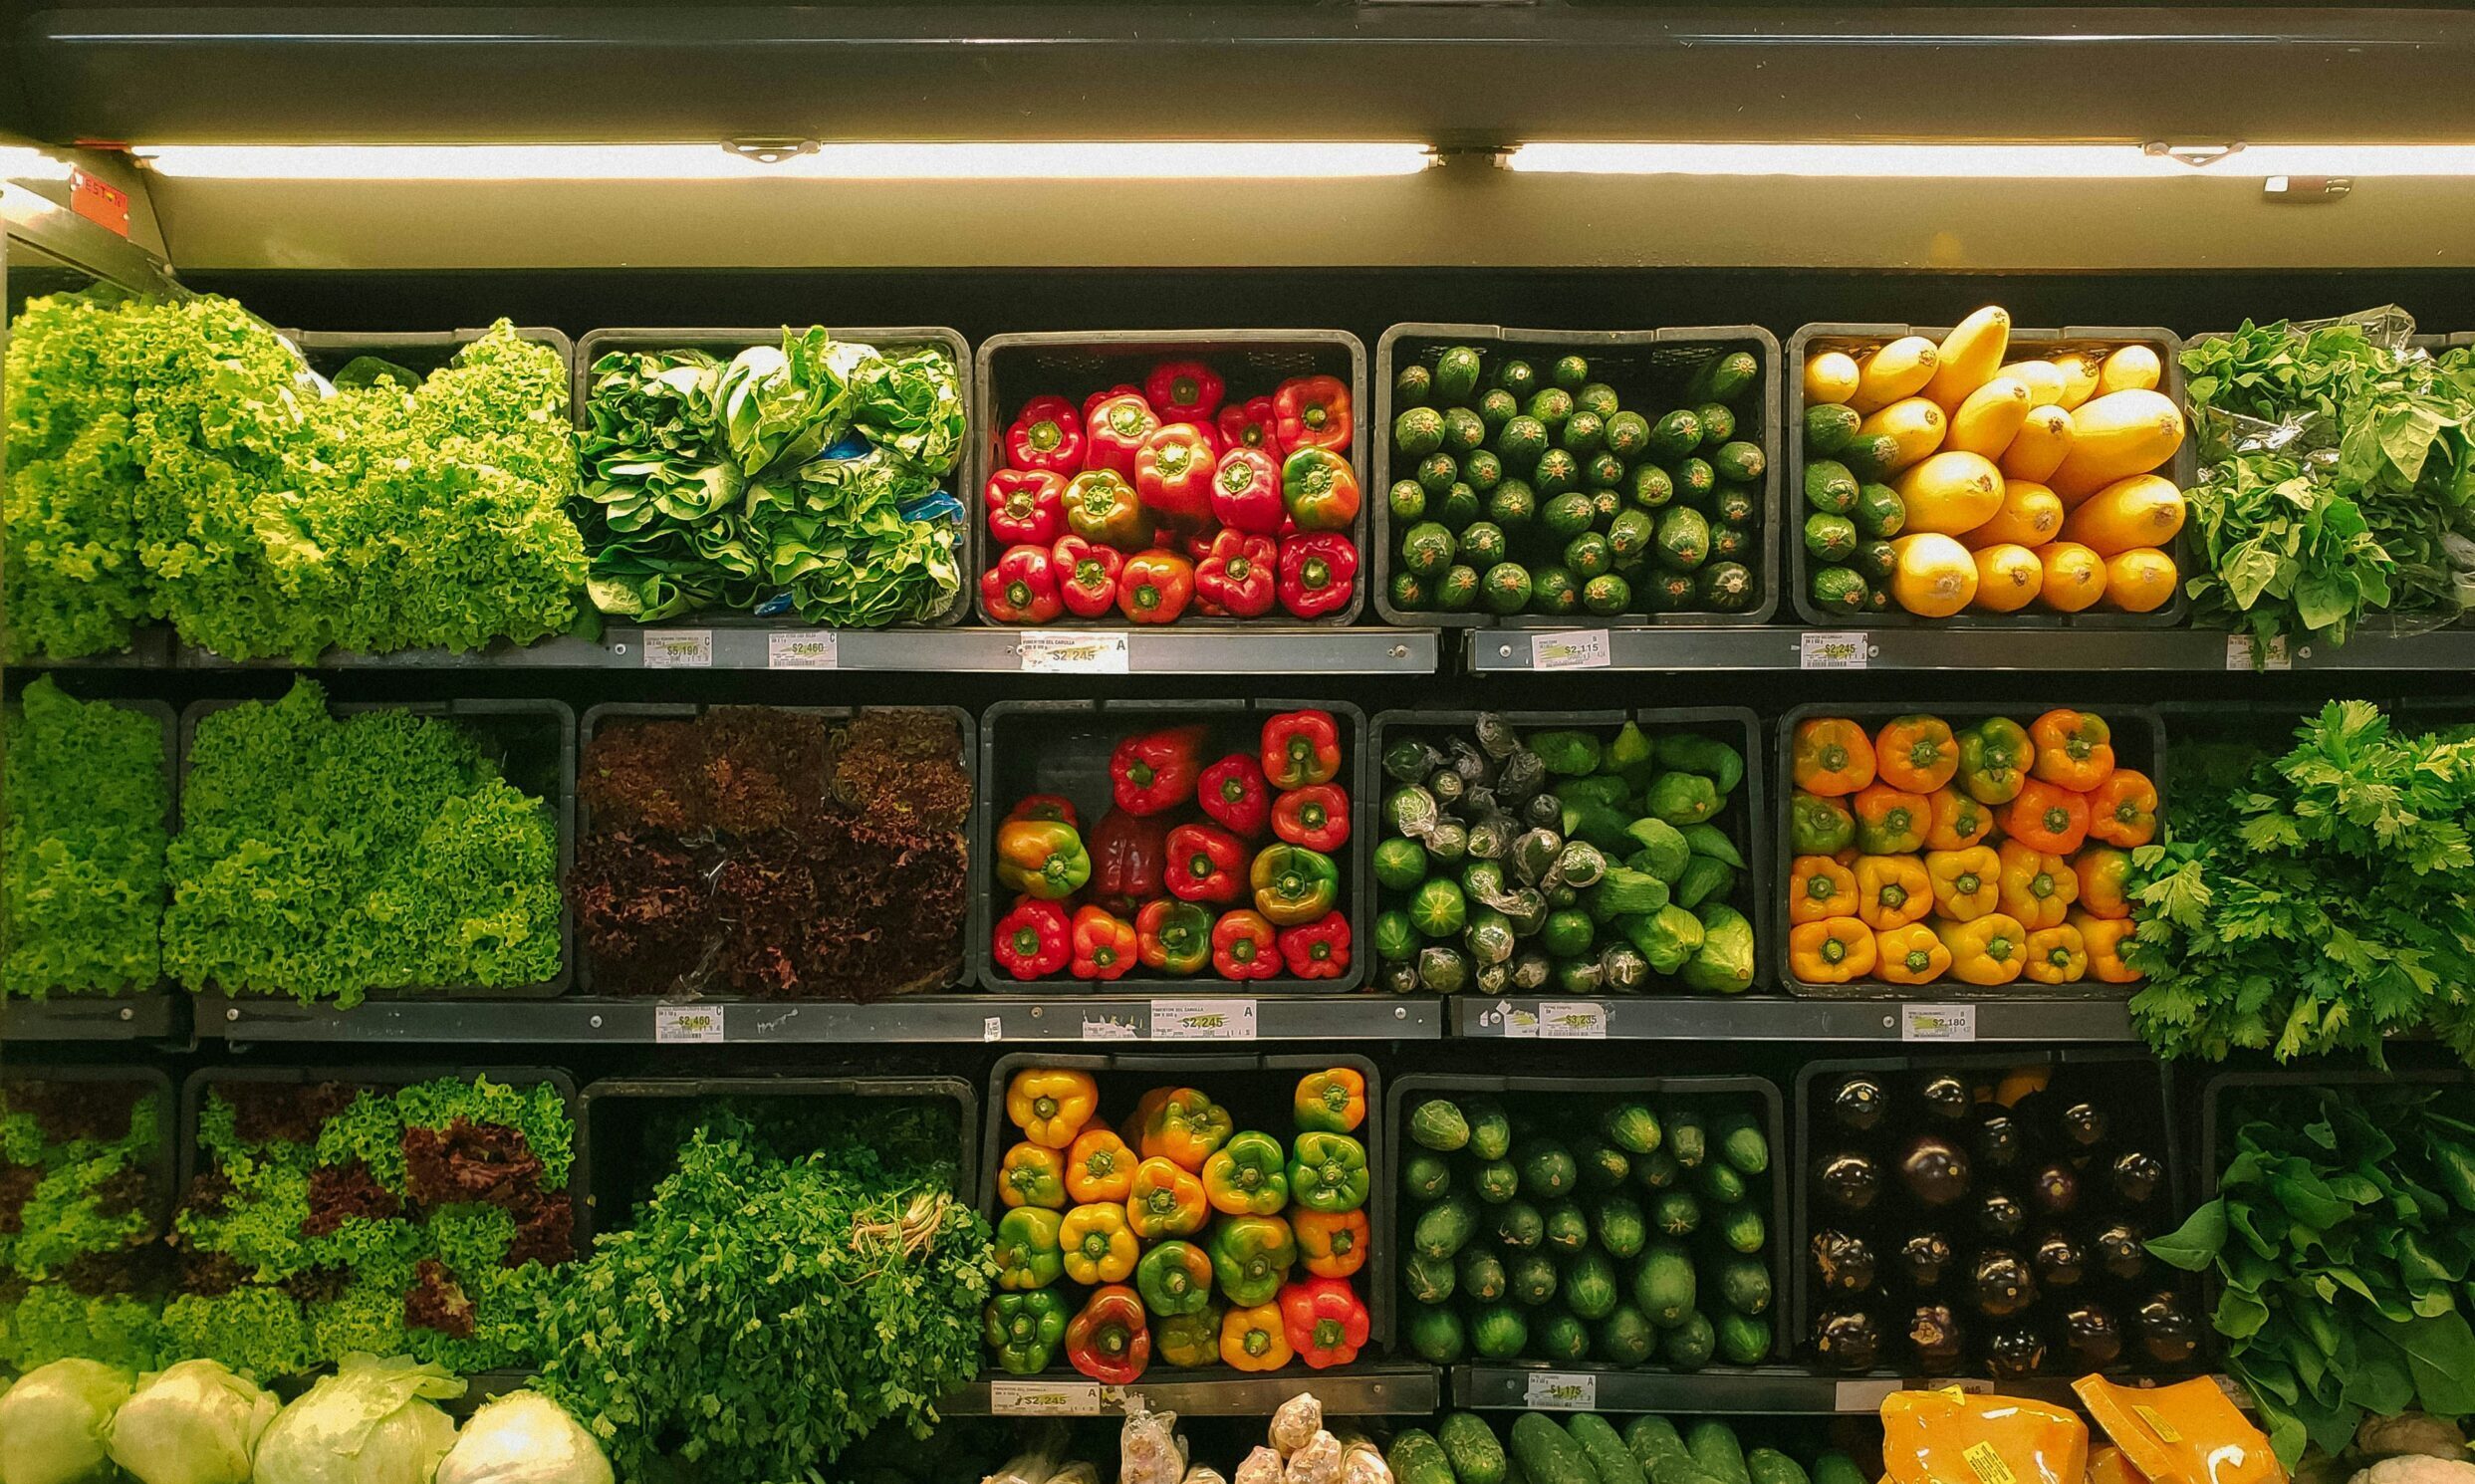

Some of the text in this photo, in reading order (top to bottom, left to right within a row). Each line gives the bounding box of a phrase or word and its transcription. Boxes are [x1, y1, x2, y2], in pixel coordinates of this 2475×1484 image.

[830, 633, 836, 642] C
[792, 642, 824, 653] $2,460
[1116, 640, 1125, 650] A
[1825, 644, 1856, 654] $2,245
[1053, 650, 1095, 661] $2245
[1244, 1007, 1252, 1016] A
[679, 1016, 710, 1027] $2,460
[1182, 1018, 1223, 1029] $2,245
[1024, 1396, 1067, 1405] $2,245
